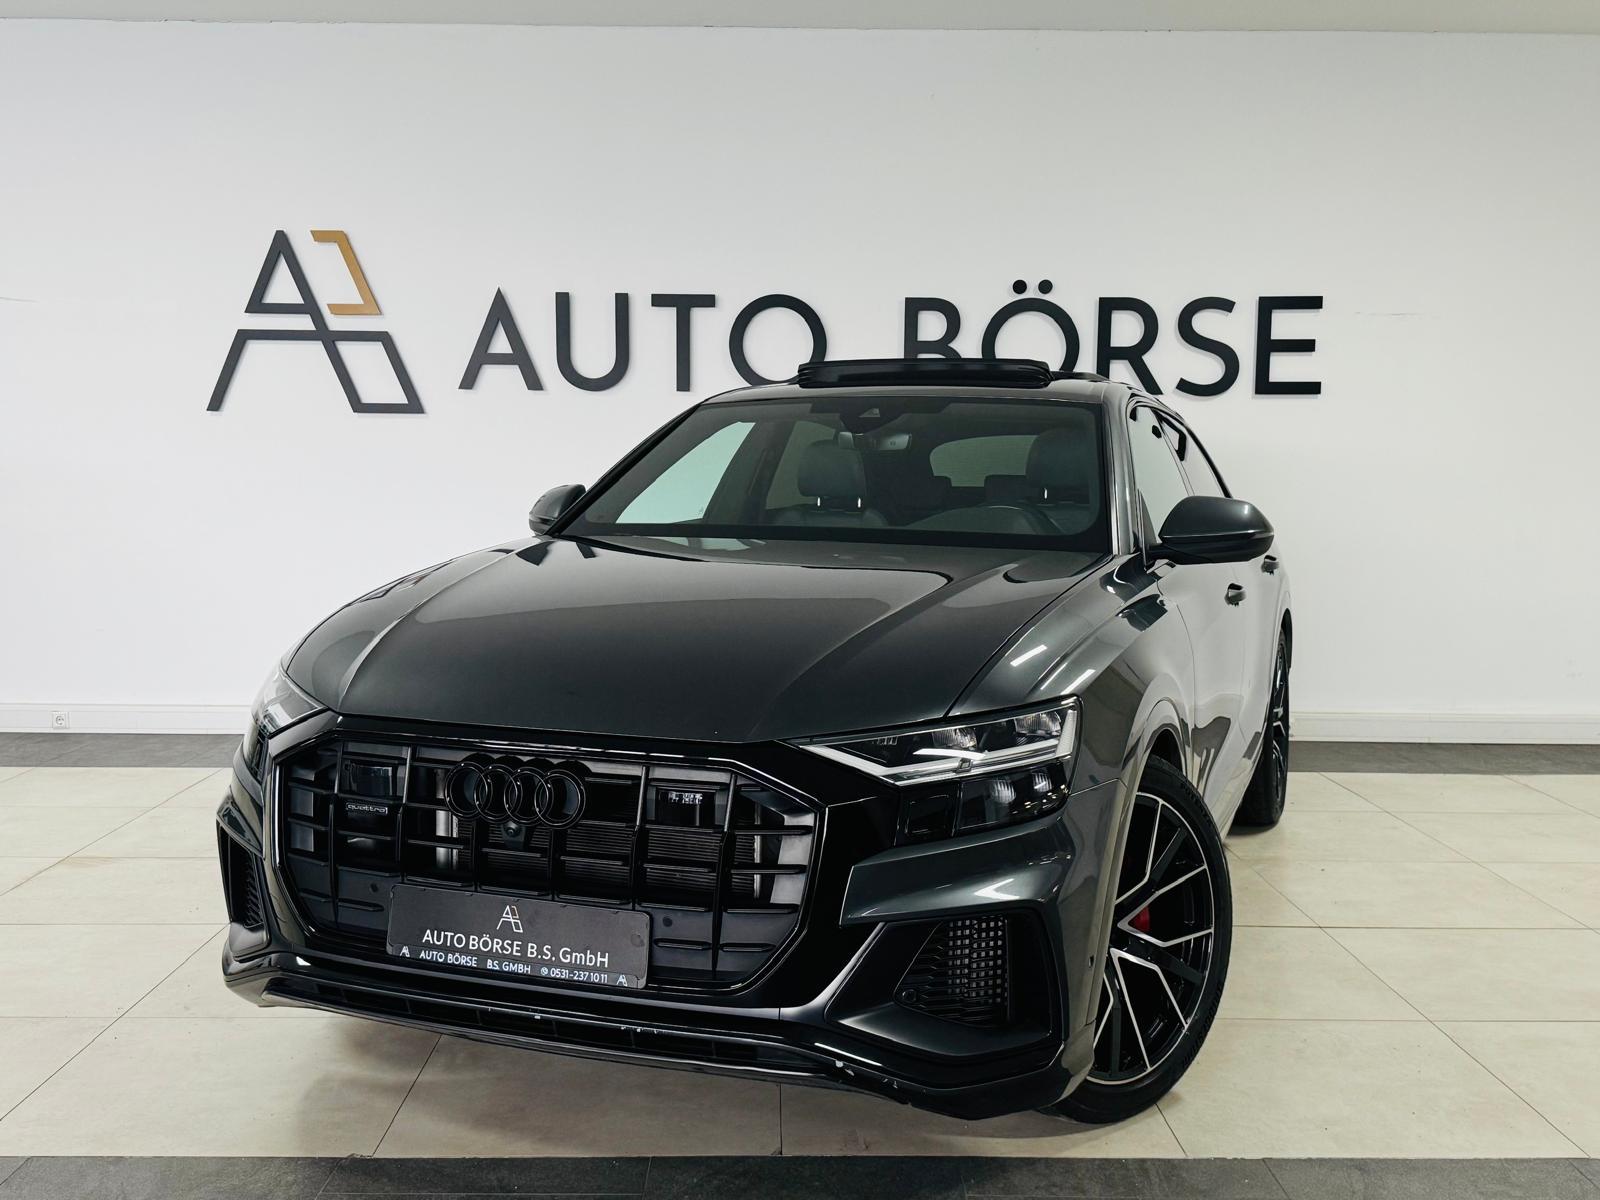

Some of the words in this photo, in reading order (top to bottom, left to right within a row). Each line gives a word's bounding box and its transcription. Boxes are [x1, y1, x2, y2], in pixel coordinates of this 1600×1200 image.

[458, 287, 828, 392] AUTO
[903, 279, 1324, 397] BÖRSE
[347, 804, 386, 813] quattro
[419, 950, 445, 962] AUTO
[447, 952, 478, 967] BÖRSE
[502, 961, 531, 974] GMBH
[422, 929, 466, 948] AUTO
[469, 934, 522, 956] BÖRSE
[527, 942, 556, 962] B.S.
[559, 947, 609, 968] GmbH
